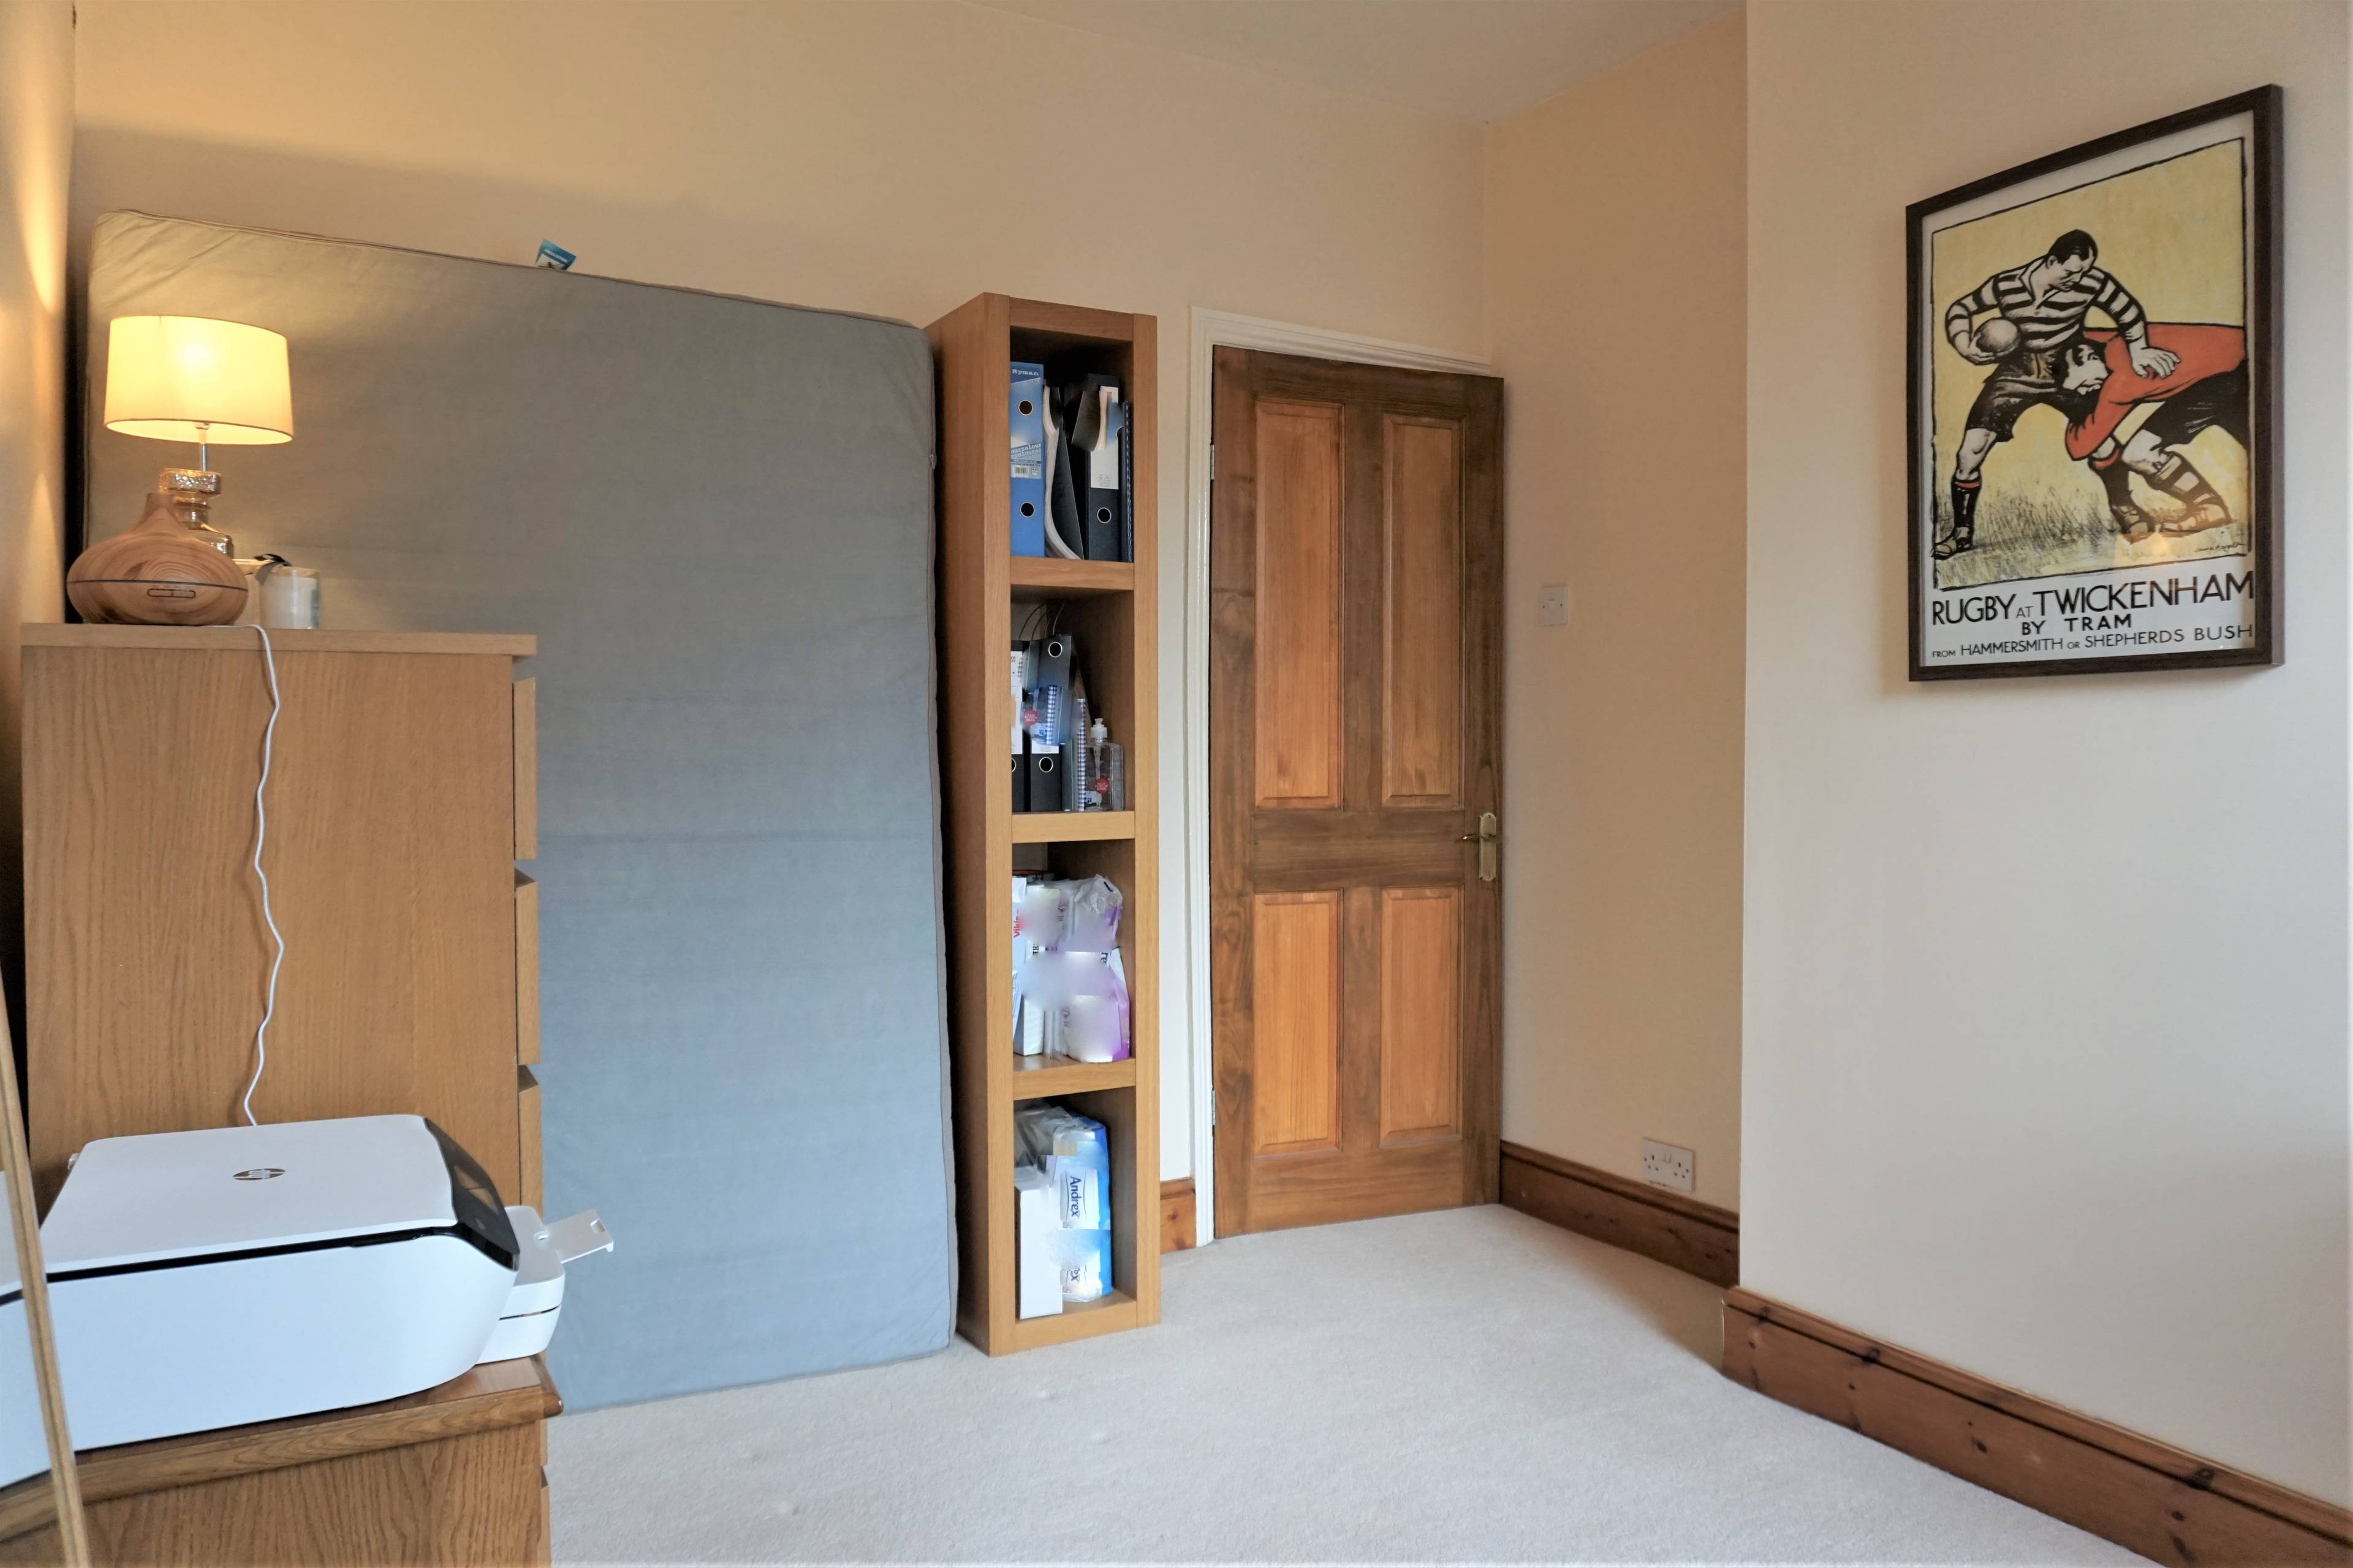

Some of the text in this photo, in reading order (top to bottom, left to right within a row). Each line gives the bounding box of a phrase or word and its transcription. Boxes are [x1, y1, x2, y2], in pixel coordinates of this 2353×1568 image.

[1932, 570, 2254, 626] RUGBY AT TWICKENHAM
[1961, 637, 2063, 656] HAMMERSMITH
[2085, 629, 2184, 648] SHEPHERDS
[2194, 624, 2253, 641] BUSH
[2022, 613, 2132, 635] BY TRAM
[1070, 1176, 1082, 1218] Andrex
